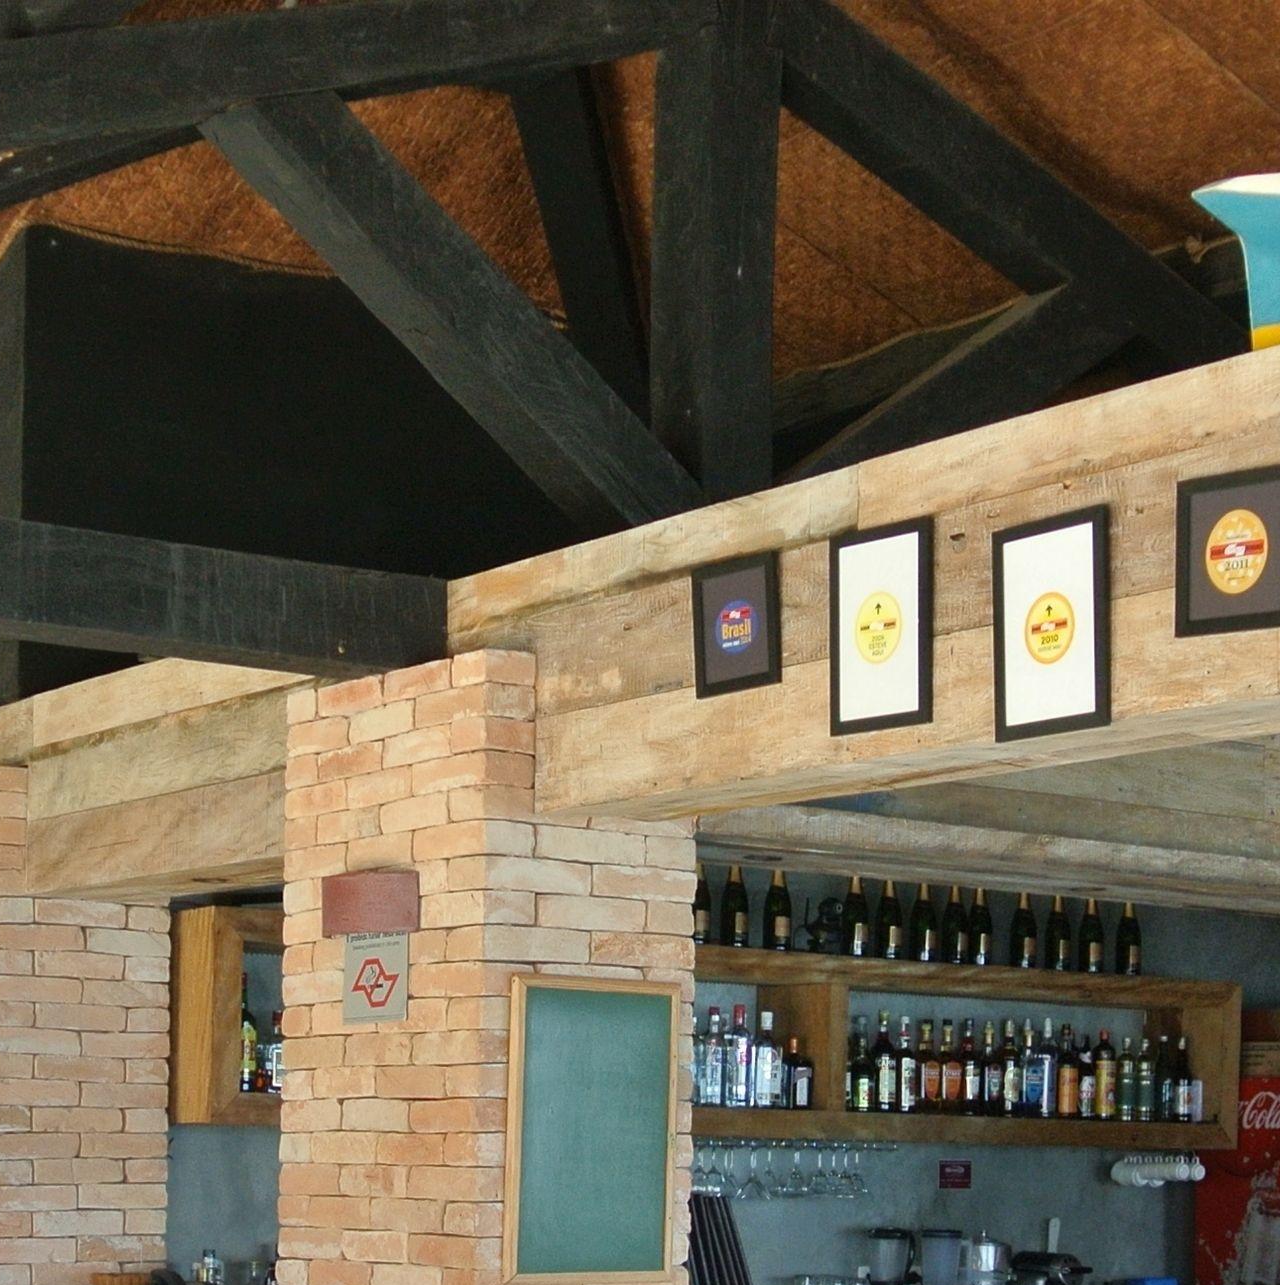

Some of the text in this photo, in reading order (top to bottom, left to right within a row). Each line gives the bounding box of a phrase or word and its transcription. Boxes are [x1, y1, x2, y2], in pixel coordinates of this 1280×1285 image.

[1225, 558, 1249, 571] 2011
[722, 618, 751, 640] Brasil
[1041, 634, 1059, 645] 2010
